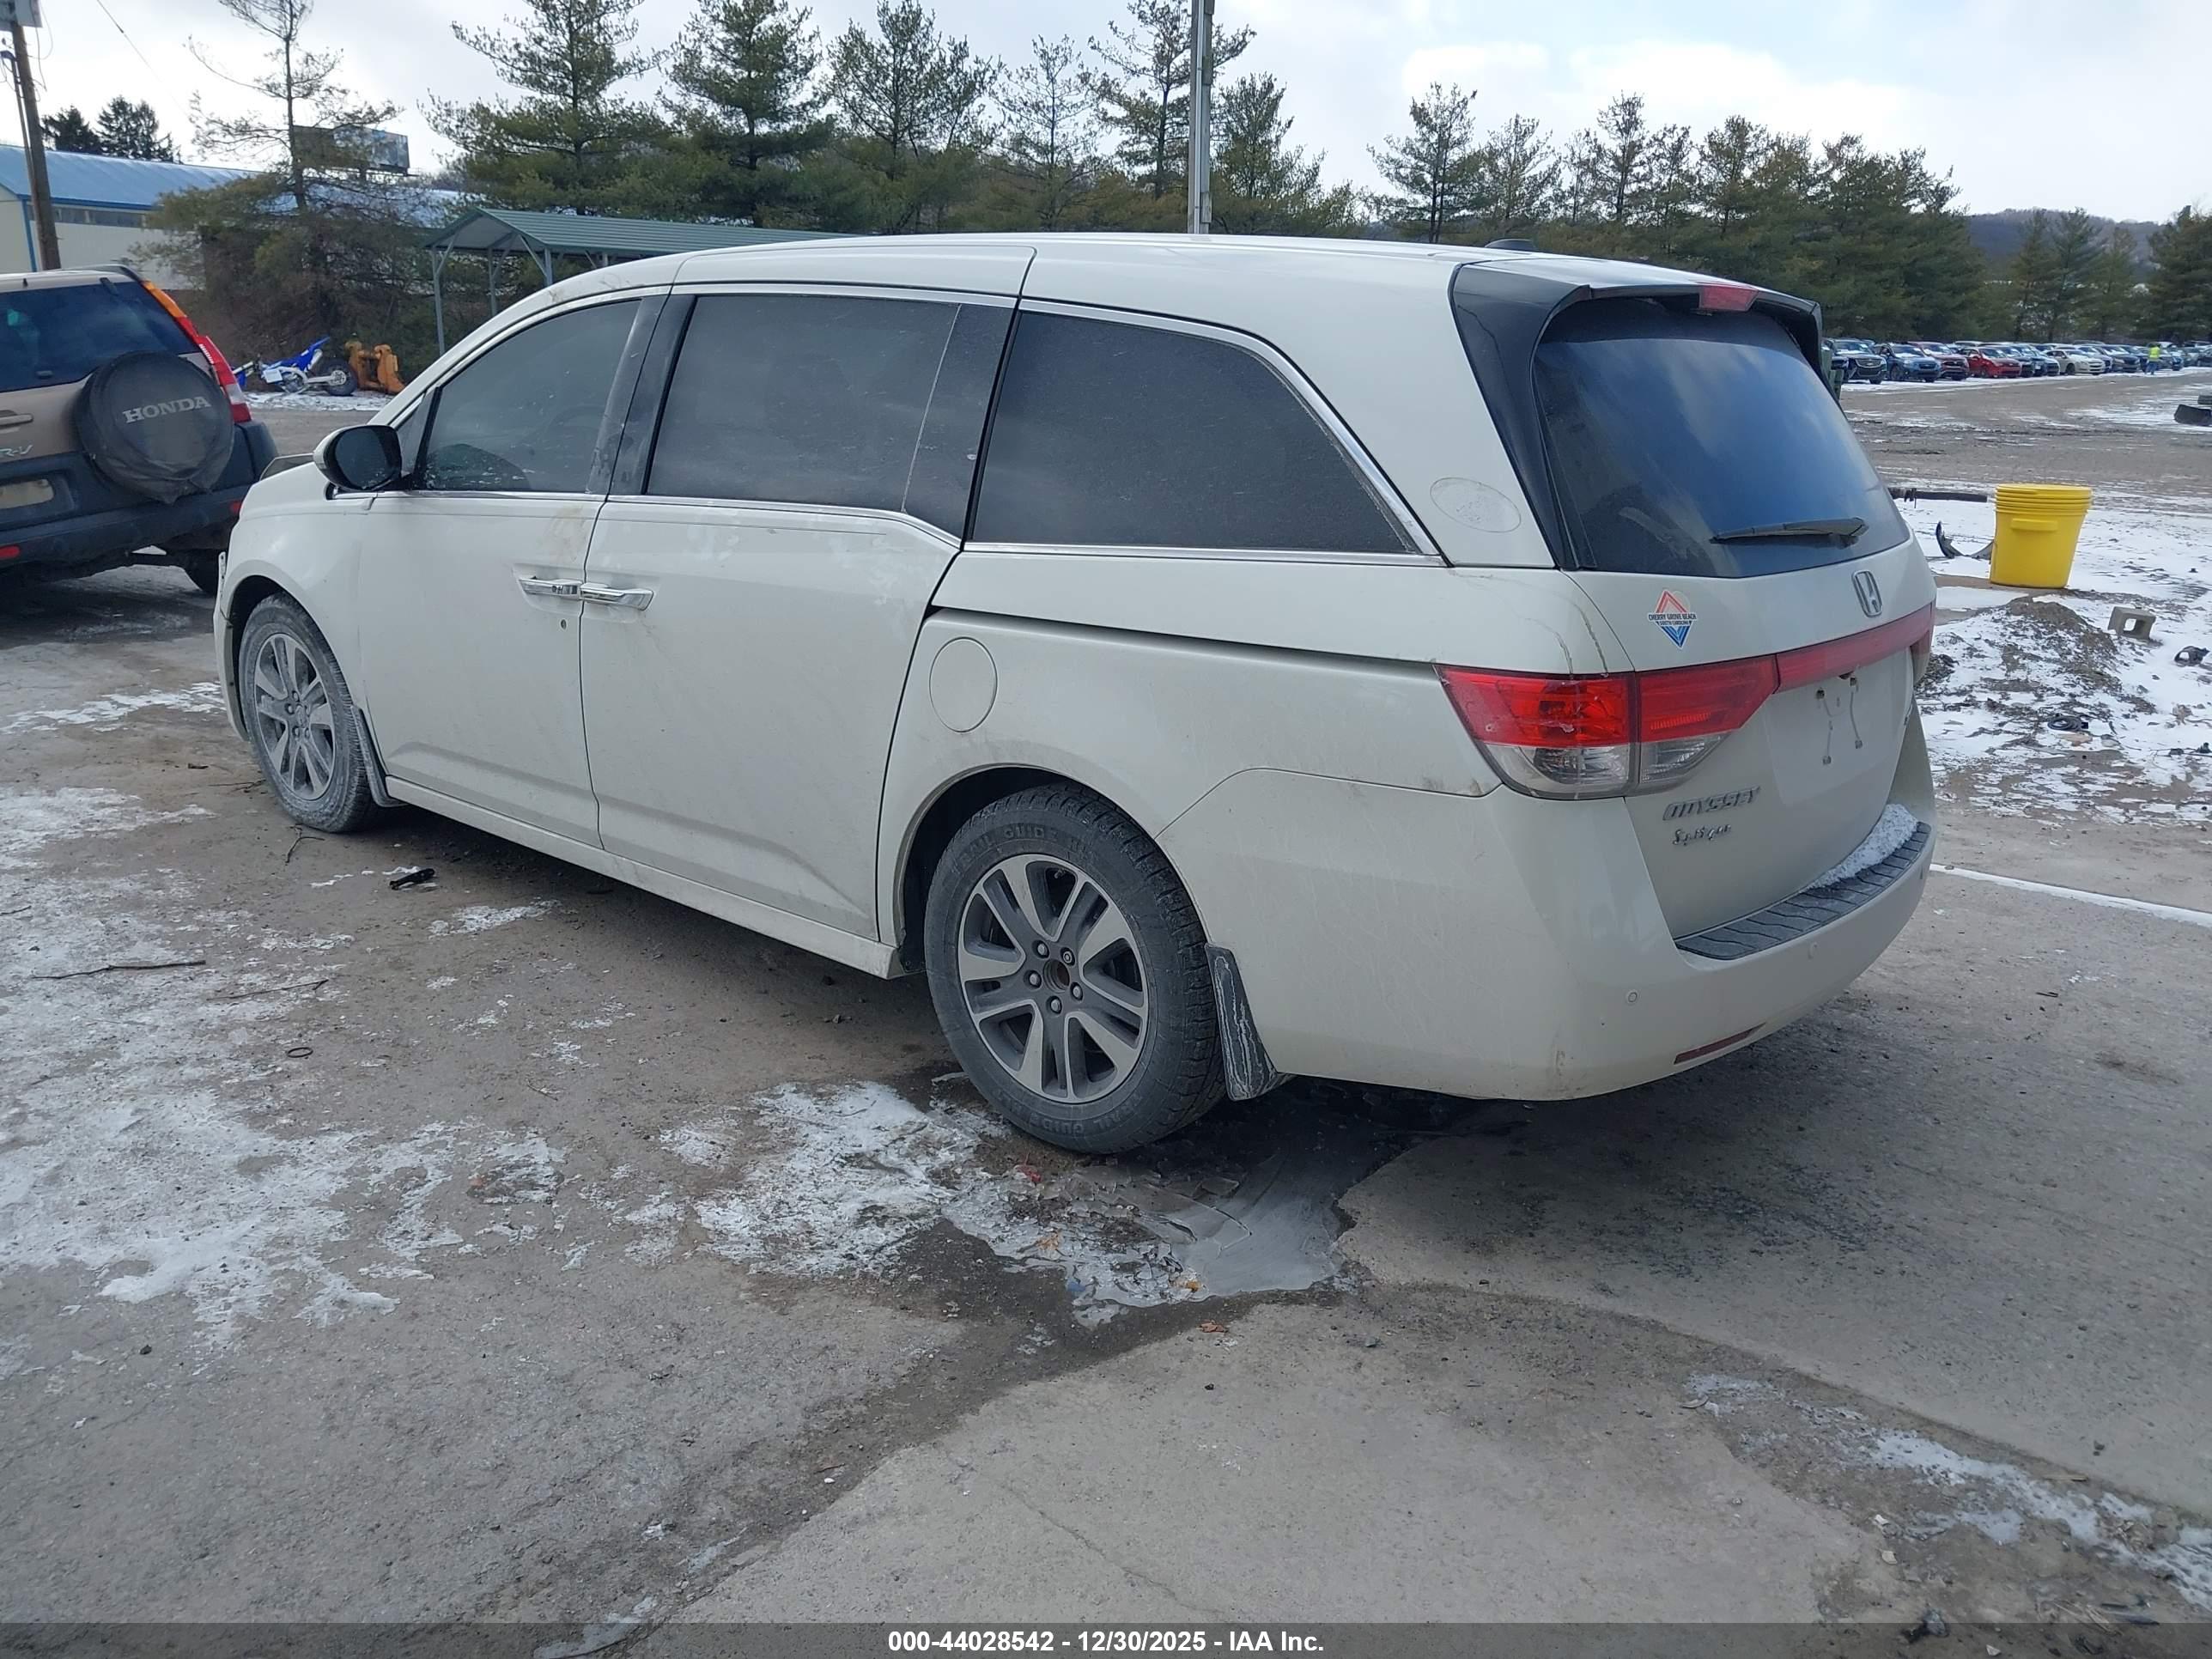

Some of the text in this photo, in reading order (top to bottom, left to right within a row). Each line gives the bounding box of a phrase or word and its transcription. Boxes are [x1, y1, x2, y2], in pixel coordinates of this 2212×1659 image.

[123, 396, 212, 423] HONDA
[0, 444, 33, 457] R-V
[1662, 786, 1759, 820] ODYSSEY
